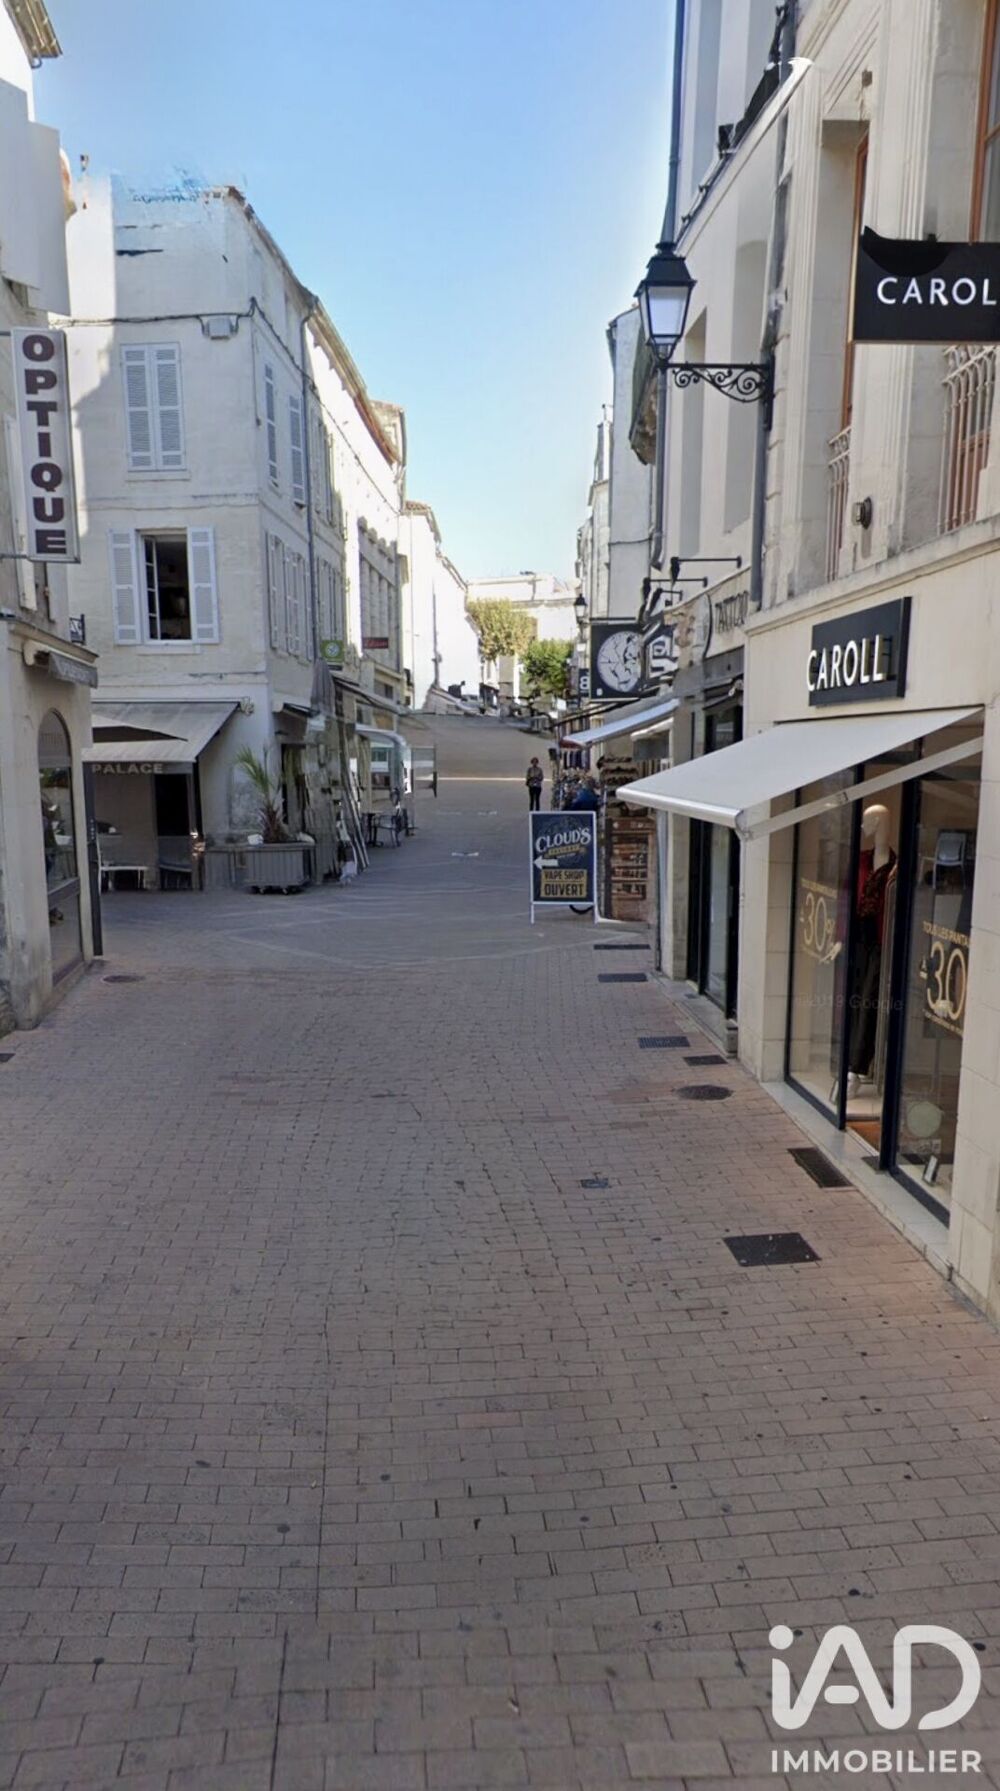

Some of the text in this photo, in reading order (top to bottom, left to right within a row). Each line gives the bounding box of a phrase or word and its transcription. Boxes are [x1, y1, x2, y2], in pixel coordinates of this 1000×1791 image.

[876, 277, 997, 306] CAROL
[22, 334, 67, 555] OPTIQUE
[806, 634, 884, 692] CAROLL
[92, 763, 164, 775] PALACE
[535, 827, 591, 852] CLOUD'S
[544, 869, 583, 880] VAPE SHOP
[544, 883, 583, 896] OUVERT
